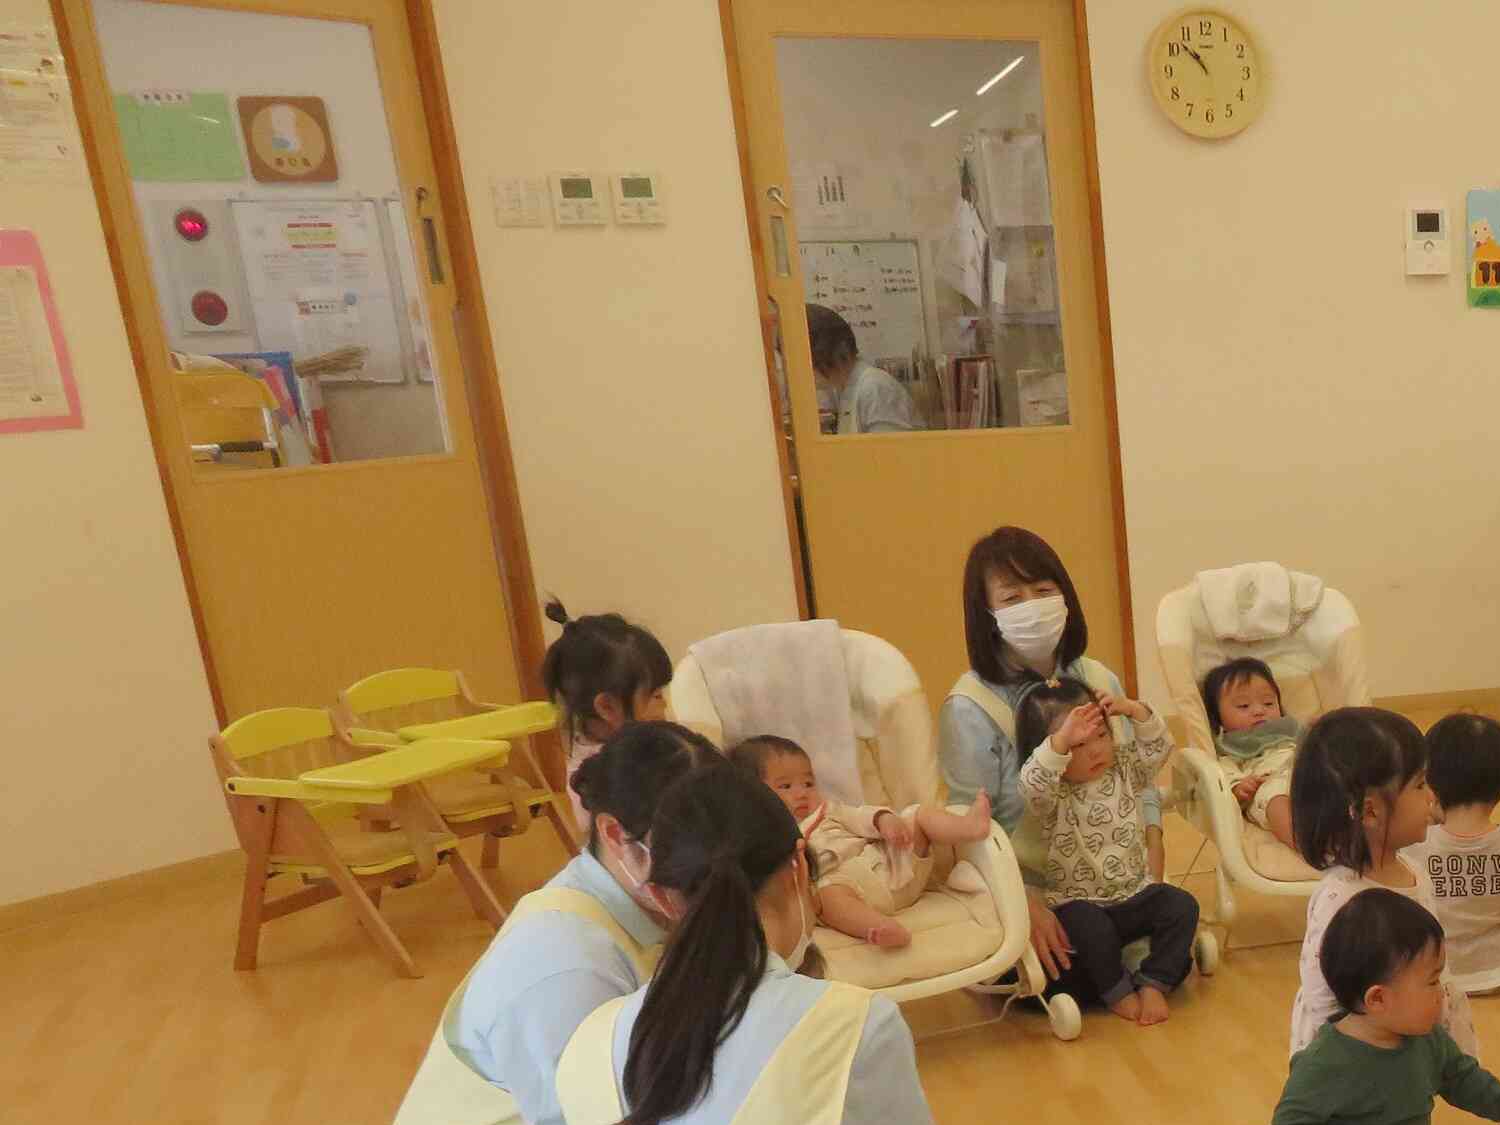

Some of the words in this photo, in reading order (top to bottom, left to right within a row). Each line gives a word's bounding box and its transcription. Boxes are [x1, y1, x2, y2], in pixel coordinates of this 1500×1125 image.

[1181, 26, 1190, 41] 11
[1199, 21, 1211, 36] 12
[1223, 27, 1228, 42] 1
[1168, 42, 1179, 57] 10
[1236, 44, 1244, 58] 2
[1164, 65, 1173, 79] 9
[1242, 66, 1250, 80] 3
[1171, 87, 1180, 101] 8
[1236, 88, 1244, 101] 4
[1186, 104, 1194, 117] 7
[1206, 109, 1214, 123] 6
[1225, 104, 1233, 118] 5
